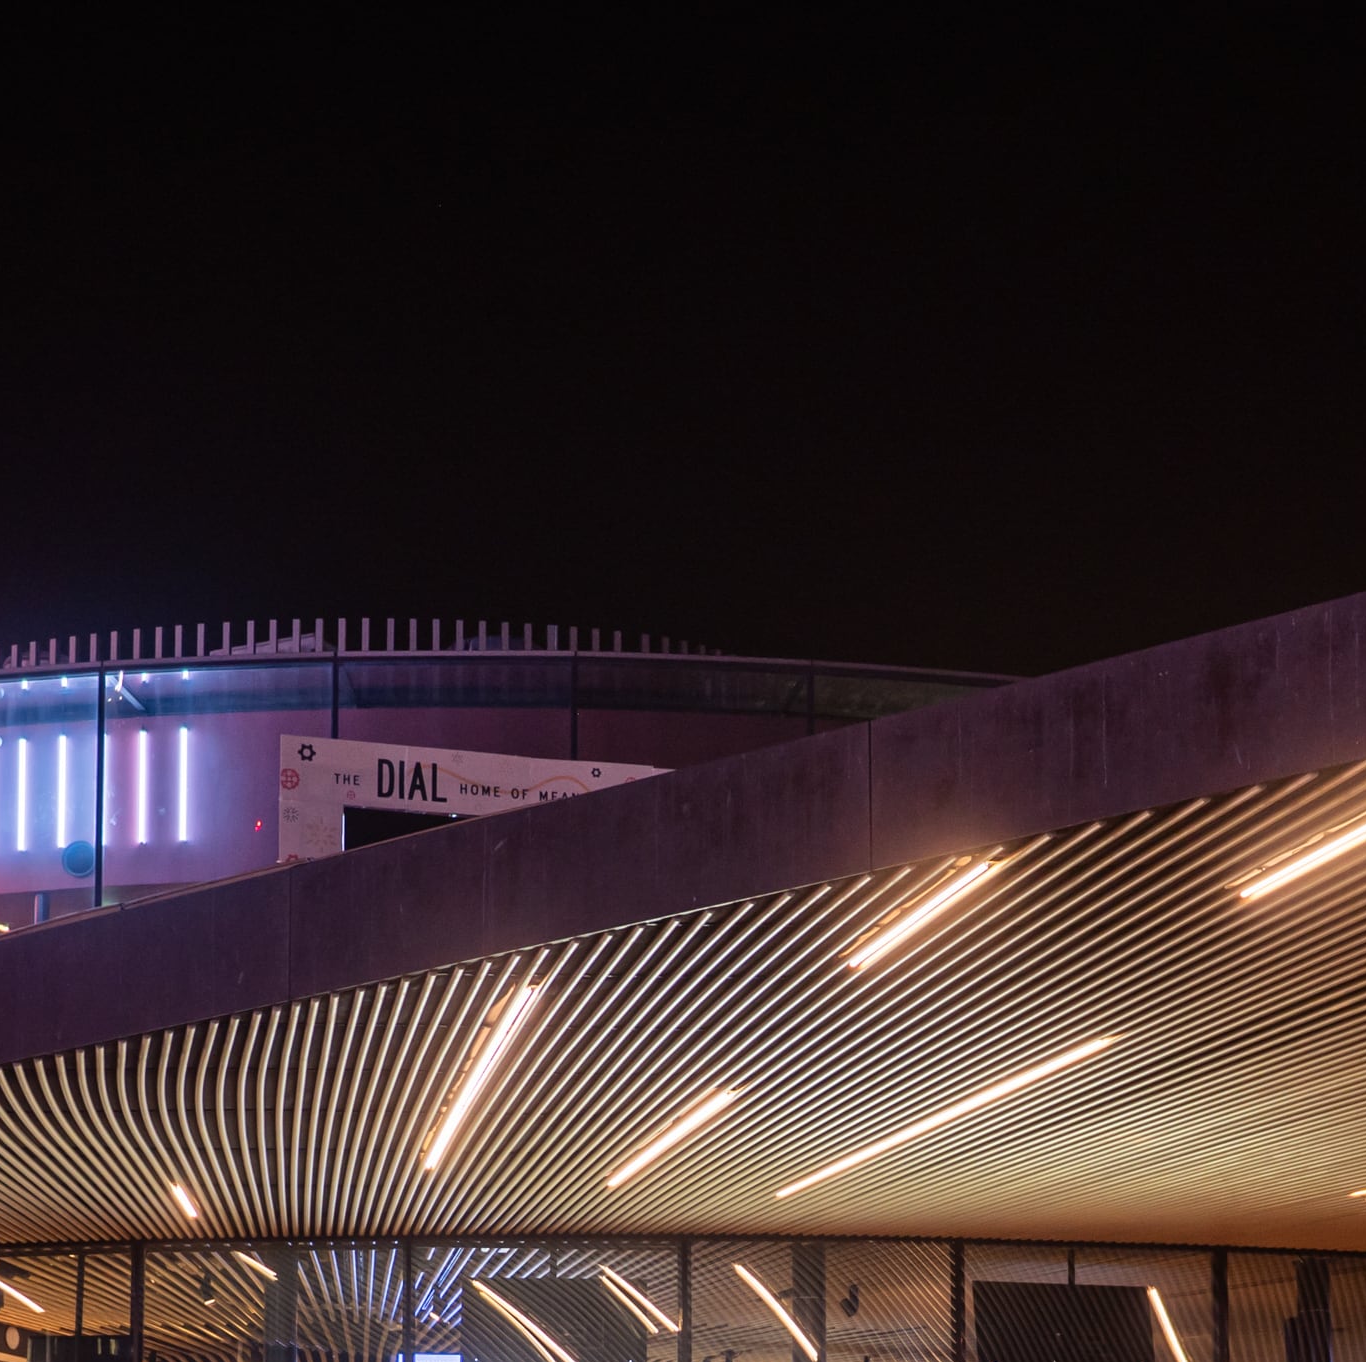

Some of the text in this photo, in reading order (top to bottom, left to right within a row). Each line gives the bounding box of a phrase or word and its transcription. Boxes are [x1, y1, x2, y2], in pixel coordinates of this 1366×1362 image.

[334, 773, 361, 786] THE
[377, 758, 447, 803] DIAL
[459, 783, 501, 798] HOME
[510, 787, 528, 800] OF
